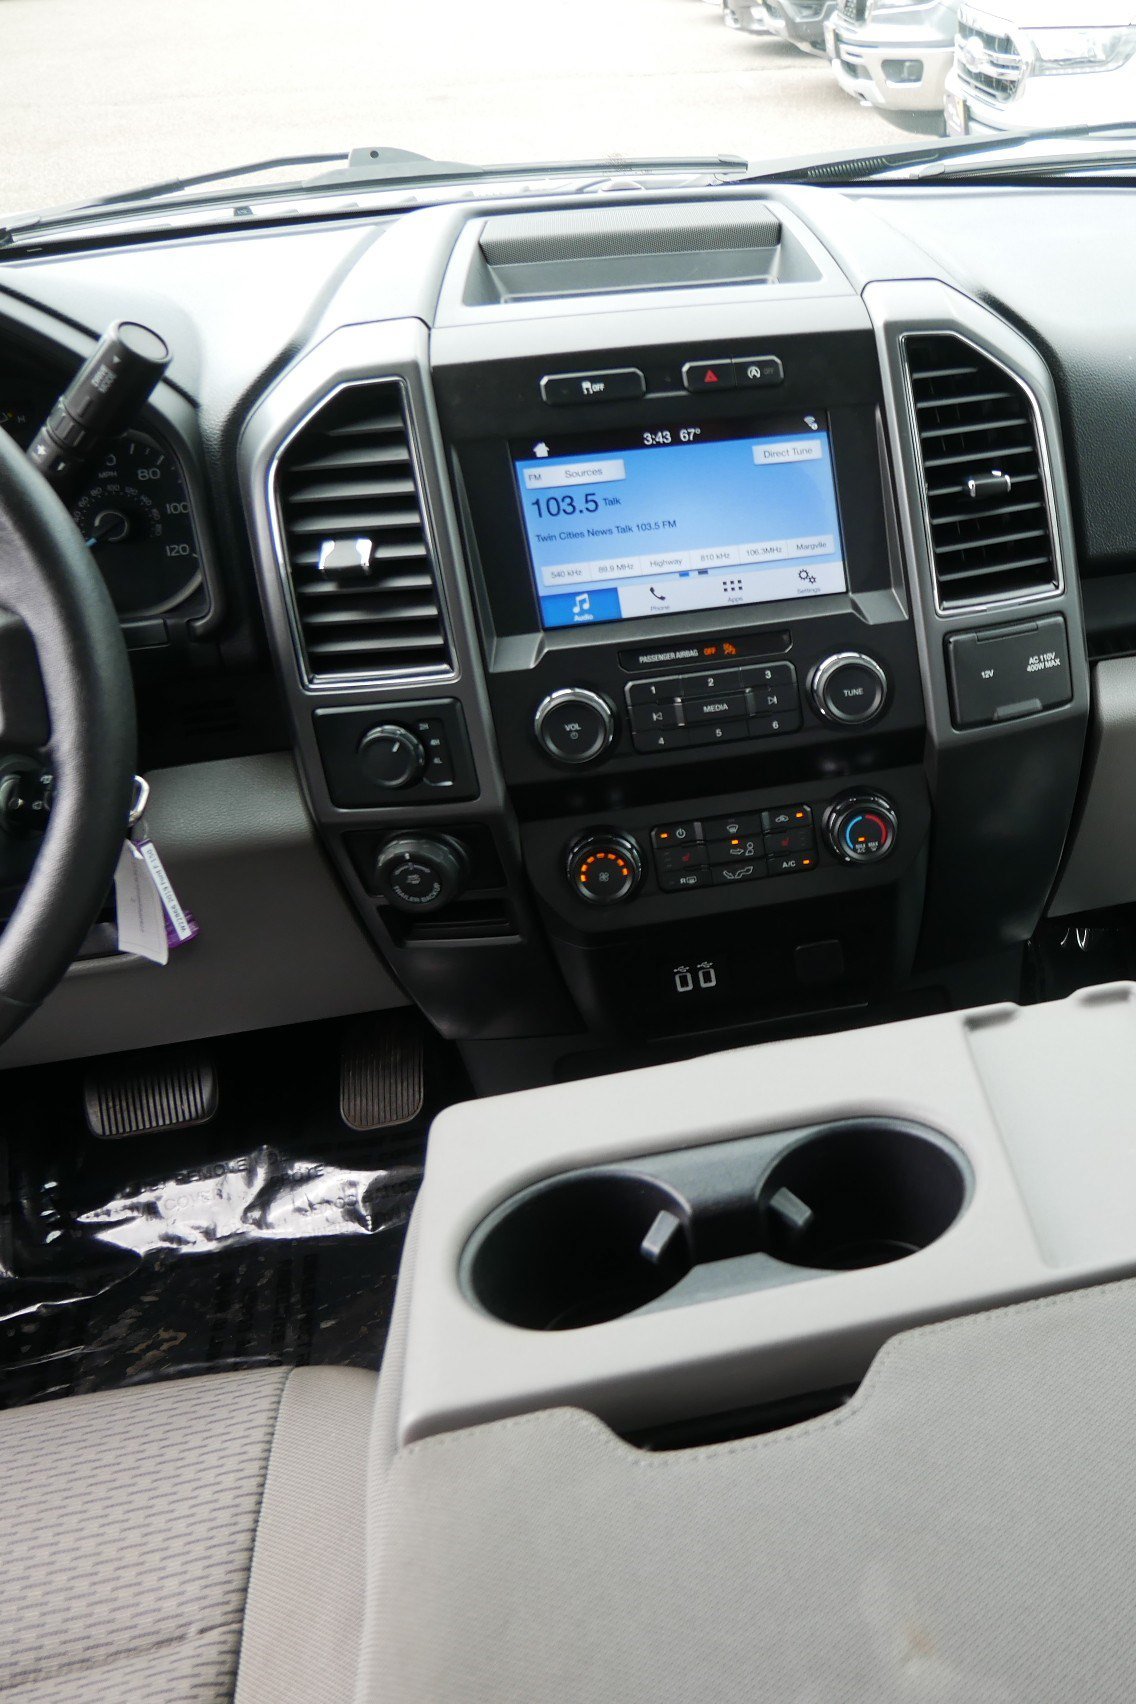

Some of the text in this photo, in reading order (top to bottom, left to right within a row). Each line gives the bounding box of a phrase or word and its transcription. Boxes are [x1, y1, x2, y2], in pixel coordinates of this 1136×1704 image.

[592, 382, 605, 392] OFF
[643, 429, 672, 445] 3:43
[763, 445, 813, 459] Direct Tune
[137, 467, 161, 481] 80
[528, 473, 542, 482] FM
[564, 466, 604, 479] Sources
[166, 502, 190, 515] 100
[531, 492, 622, 519] 103.5 Talk
[536, 519, 677, 543] Twin Cities News Talk 103.5 FM
[166, 544, 190, 557] 120
[650, 557, 683, 568] Highway
[551, 570, 566, 579] 540
[728, 595, 744, 604] Apps
[574, 613, 594, 622] Audio
[638, 646, 718, 664] PASSENGER AIRBAG OFF
[1028, 651, 1056, 665] AC 110V
[1026, 657, 1061, 673] 400W MAX
[765, 670, 772, 679] 3
[981, 669, 994, 680] 12V
[708, 678, 714, 686] 2
[650, 685, 656, 694] 1
[843, 687, 864, 697] TUNE
[703, 702, 729, 714] MEDIA
[564, 722, 582, 732] VOL
[772, 721, 779, 730] 6
[715, 729, 722, 737] 5
[658, 737, 665, 746] 4
[782, 859, 796, 869] A/C
[420, 882, 441, 903] BACKUP
